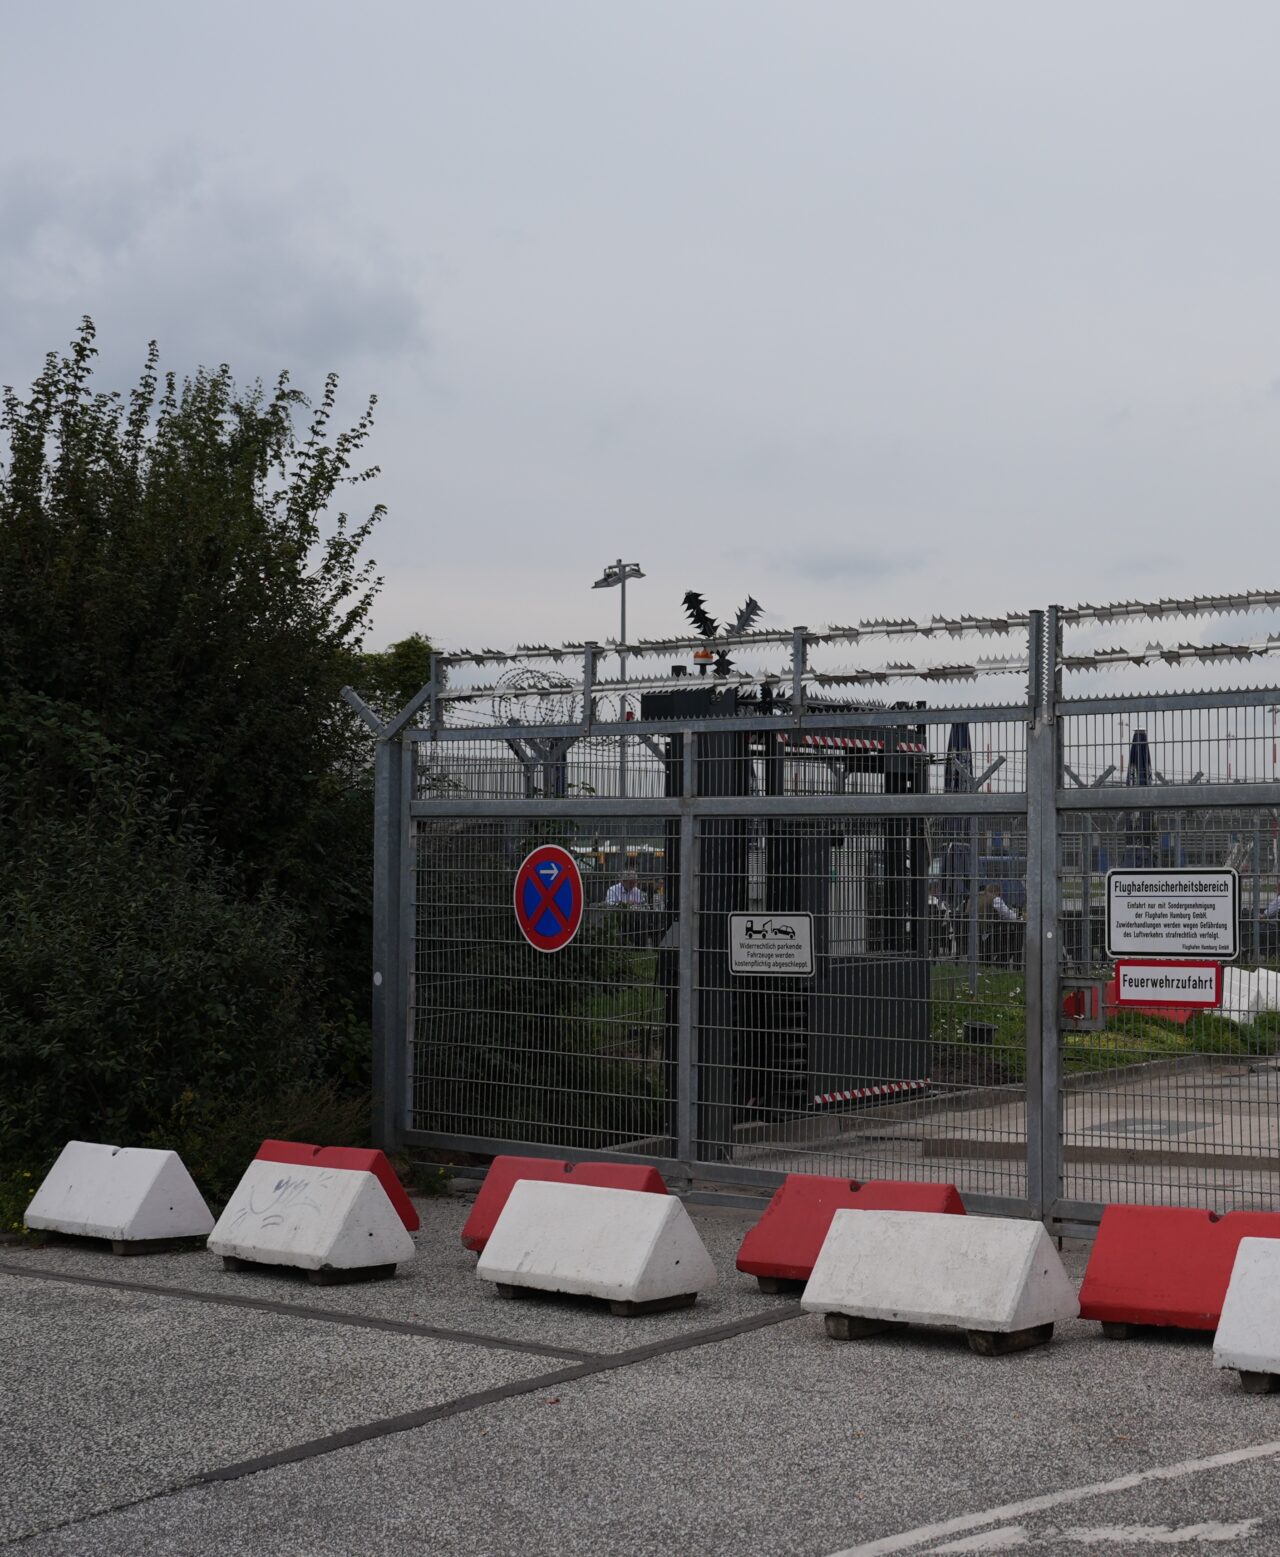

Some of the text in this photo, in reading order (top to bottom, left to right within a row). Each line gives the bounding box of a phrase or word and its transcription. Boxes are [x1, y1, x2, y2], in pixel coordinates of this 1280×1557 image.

[1114, 880, 1229, 895] Flughafensicherheitsbereich
[1167, 902, 1216, 910] Sondergenehmigung
[1135, 911, 1143, 919] der
[1144, 911, 1168, 920] Flughafen
[1169, 912, 1191, 920] Hamburg
[1116, 921, 1161, 930] Zuwiderhandlungen
[1163, 921, 1180, 929] werden
[1199, 921, 1227, 930] Gefährdung
[1165, 931, 1197, 939] strafrechtlich
[1199, 931, 1220, 940] verfolgt.
[739, 942, 776, 950] Widerrechtlich
[746, 951, 774, 959] Fahrzeuge
[734, 960, 771, 968] kostenpflichtig
[1122, 973, 1213, 990] Feuerwehrzufahrt
